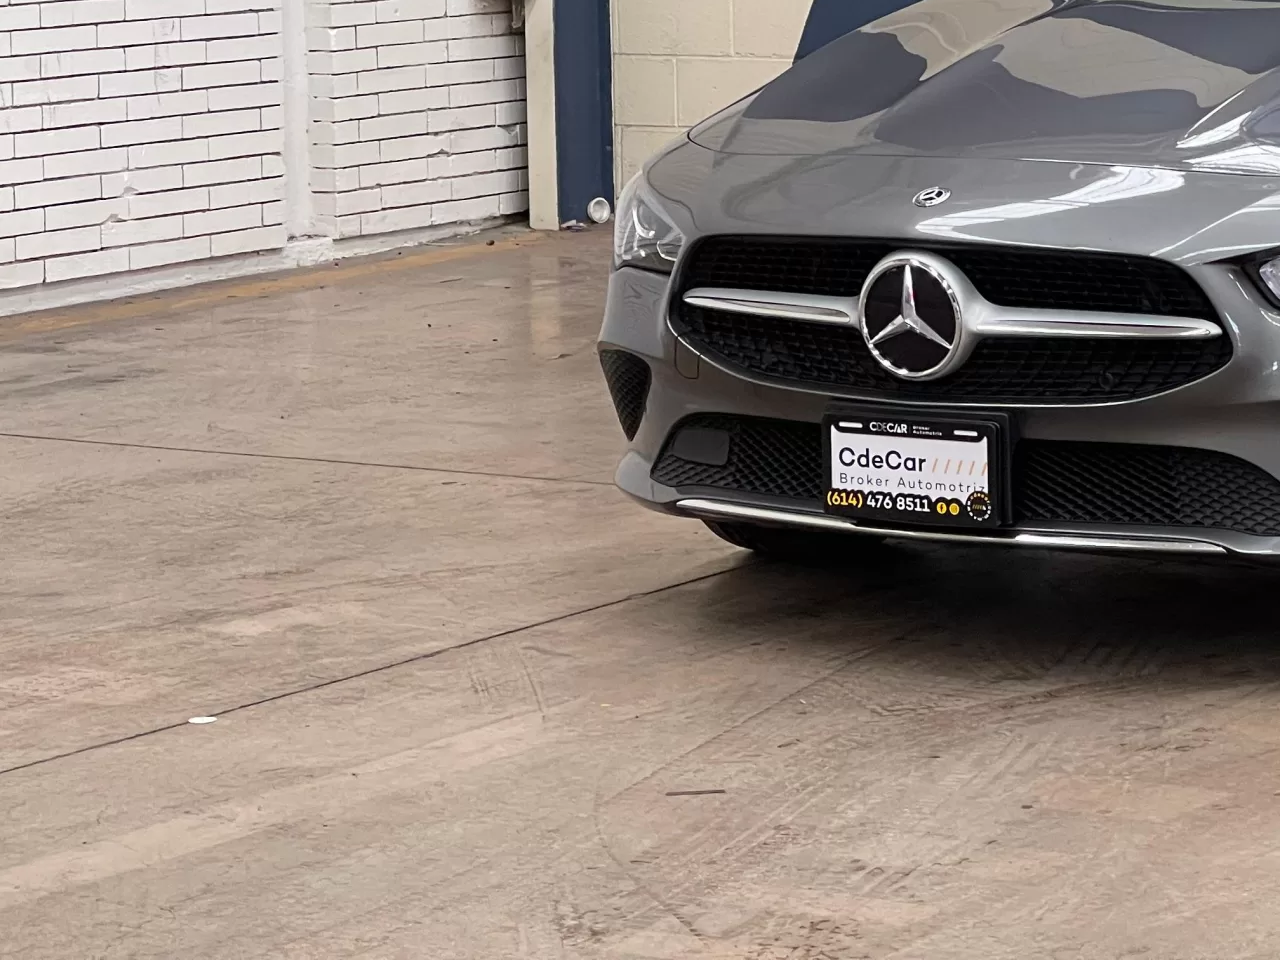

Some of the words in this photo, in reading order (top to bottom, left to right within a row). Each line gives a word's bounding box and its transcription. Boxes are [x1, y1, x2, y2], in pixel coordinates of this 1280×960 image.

[839, 447, 926, 472] CdeCar
[839, 472, 890, 487] Broker
[897, 477, 985, 493] Automotriz
[827, 491, 863, 508] (614)
[866, 494, 893, 509] 476
[896, 496, 930, 512] 8511
